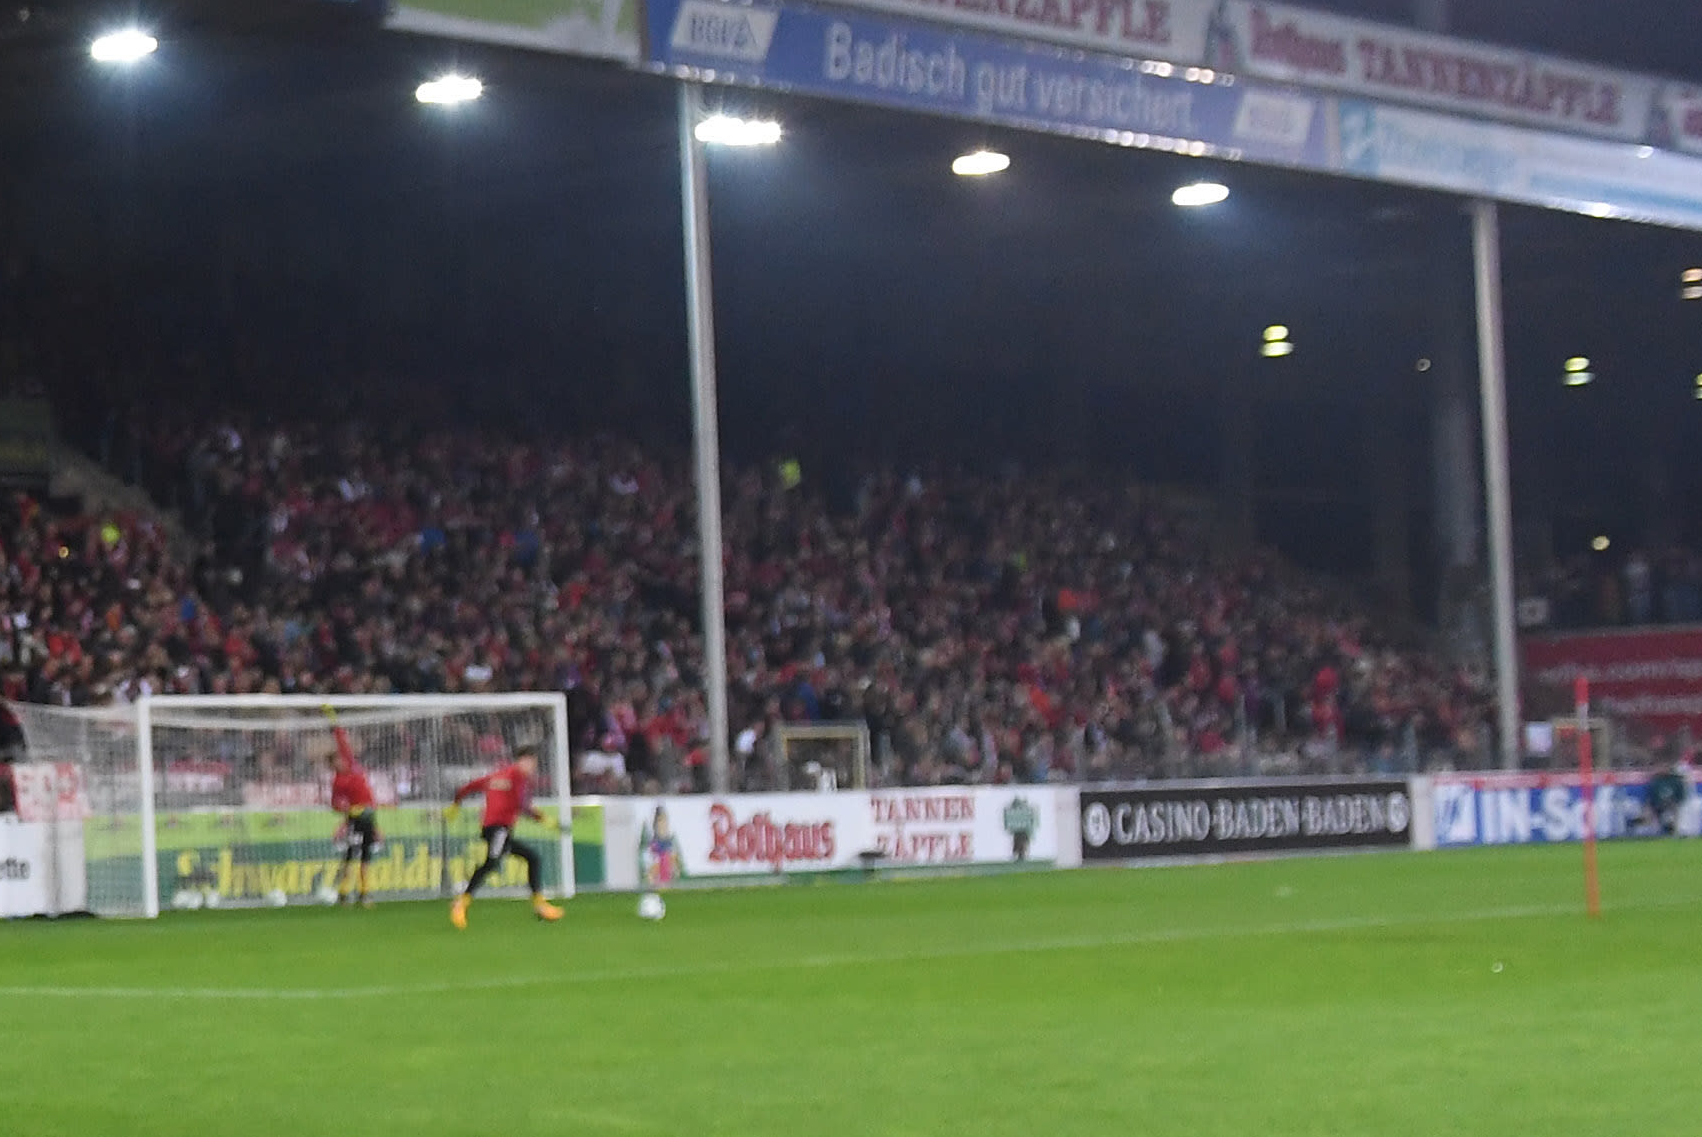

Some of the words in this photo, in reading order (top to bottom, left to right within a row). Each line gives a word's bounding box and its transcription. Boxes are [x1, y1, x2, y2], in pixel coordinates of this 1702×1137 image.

[823, 21, 967, 99] Badisch
[977, 64, 1028, 119] gut
[1037, 75, 1194, 131] versichert
[709, 801, 838, 873] Rothaus
[871, 795, 976, 823] TANNEN
[1112, 800, 1210, 845] CASINO
